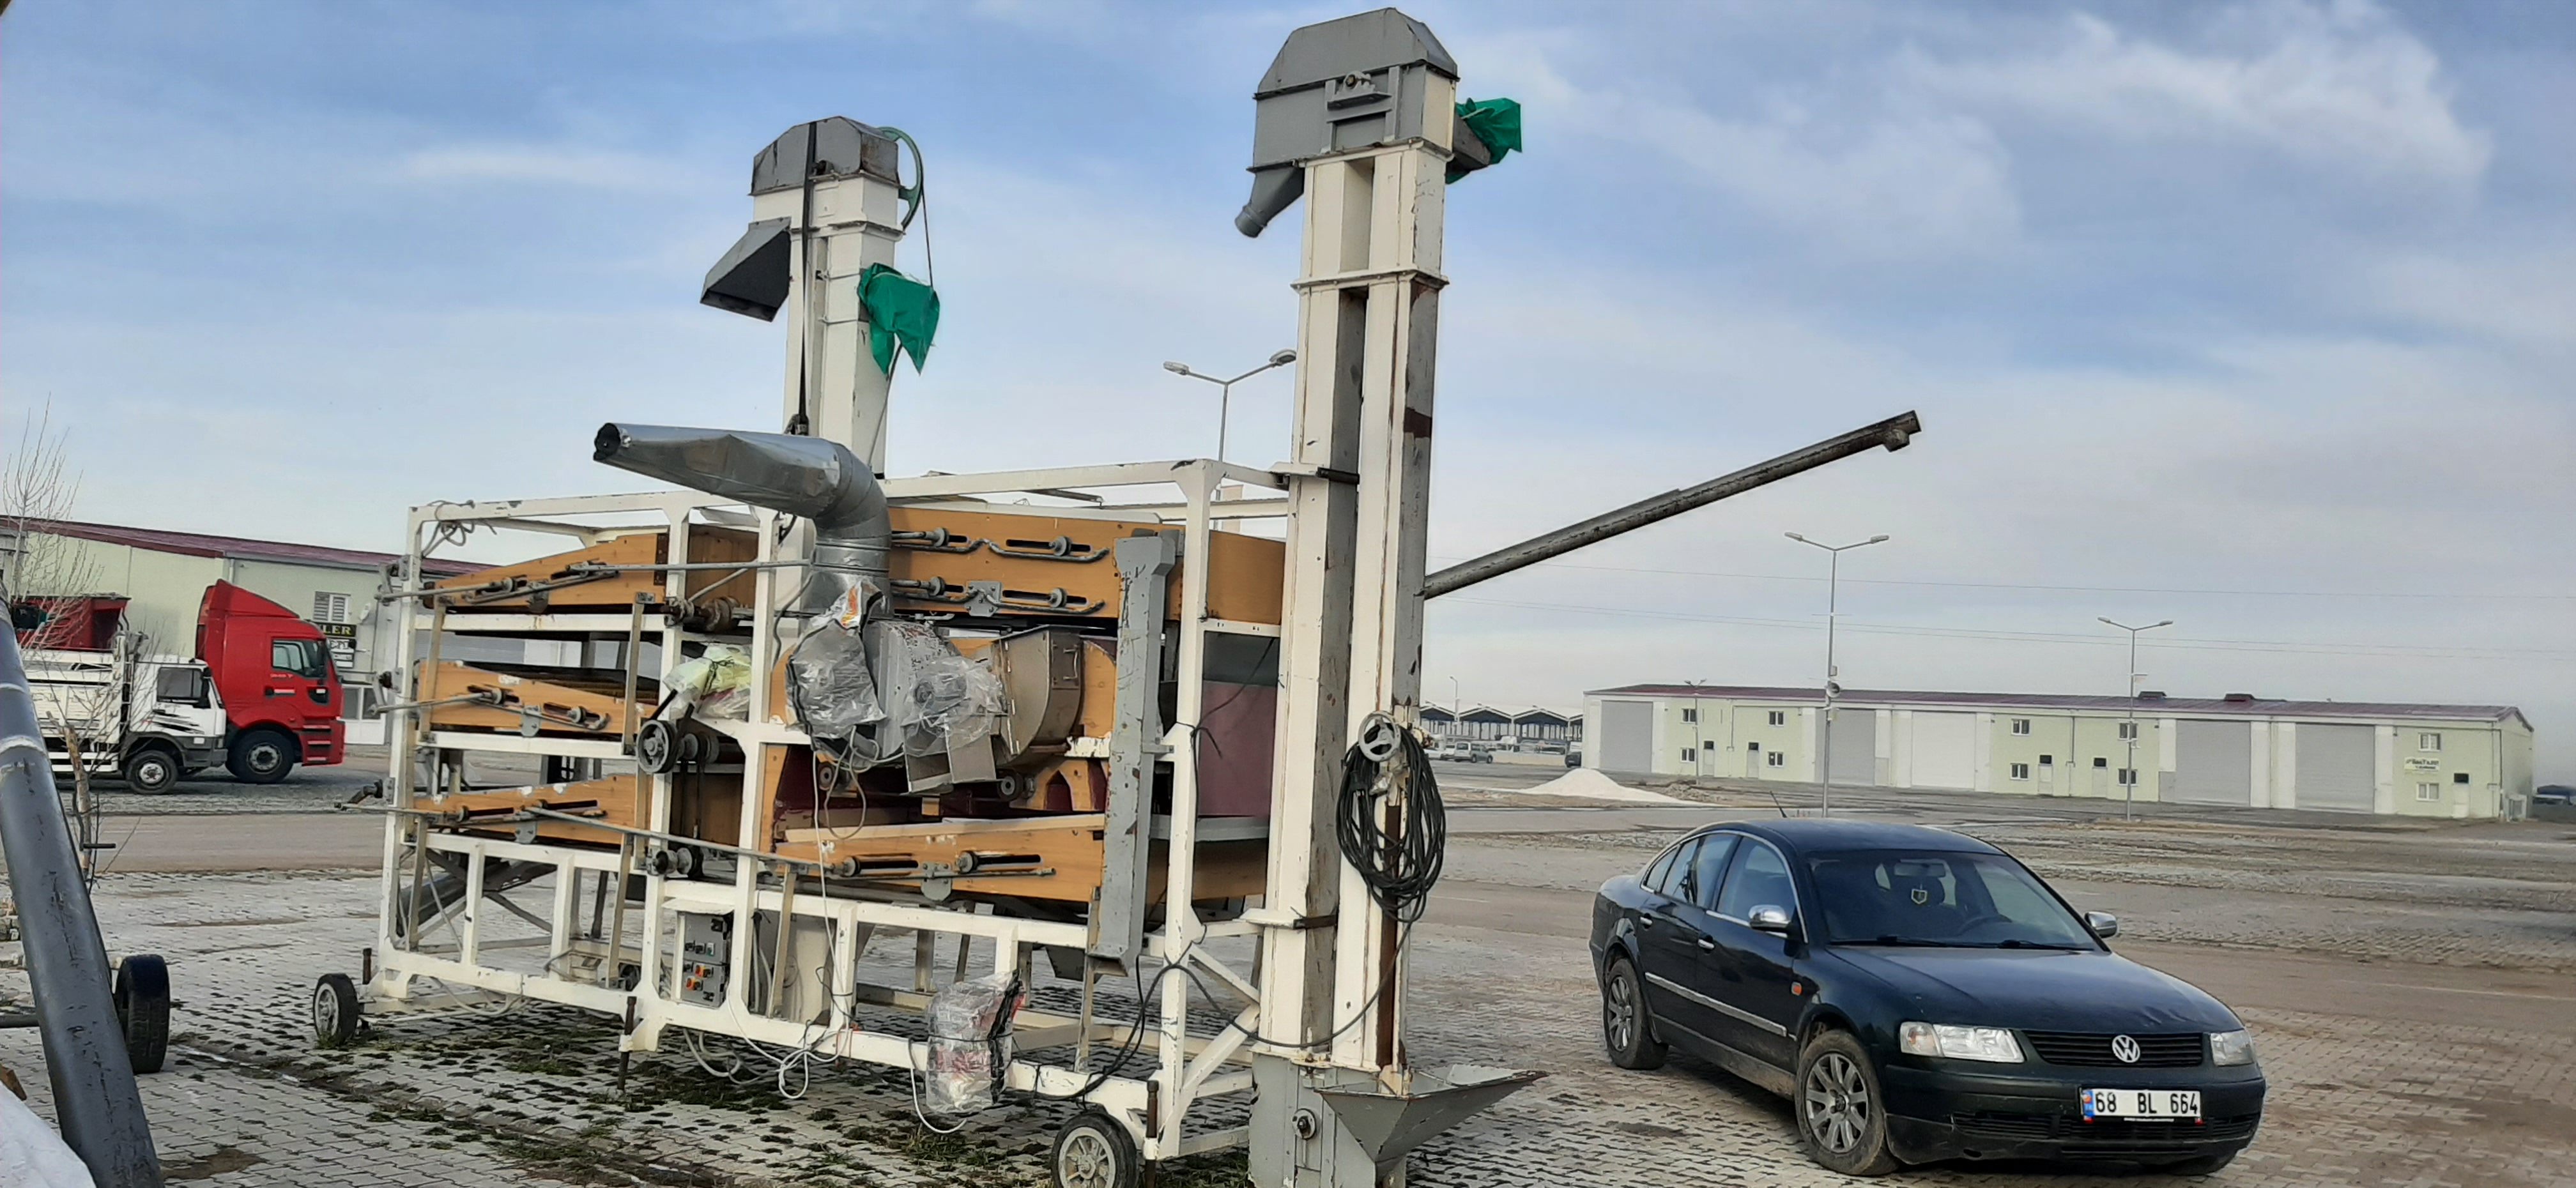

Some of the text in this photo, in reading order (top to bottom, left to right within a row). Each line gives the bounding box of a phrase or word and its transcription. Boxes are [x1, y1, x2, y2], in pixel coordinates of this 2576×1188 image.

[319, 625, 352, 636] LER
[2096, 1092, 2198, 1114] 68 BL 664
